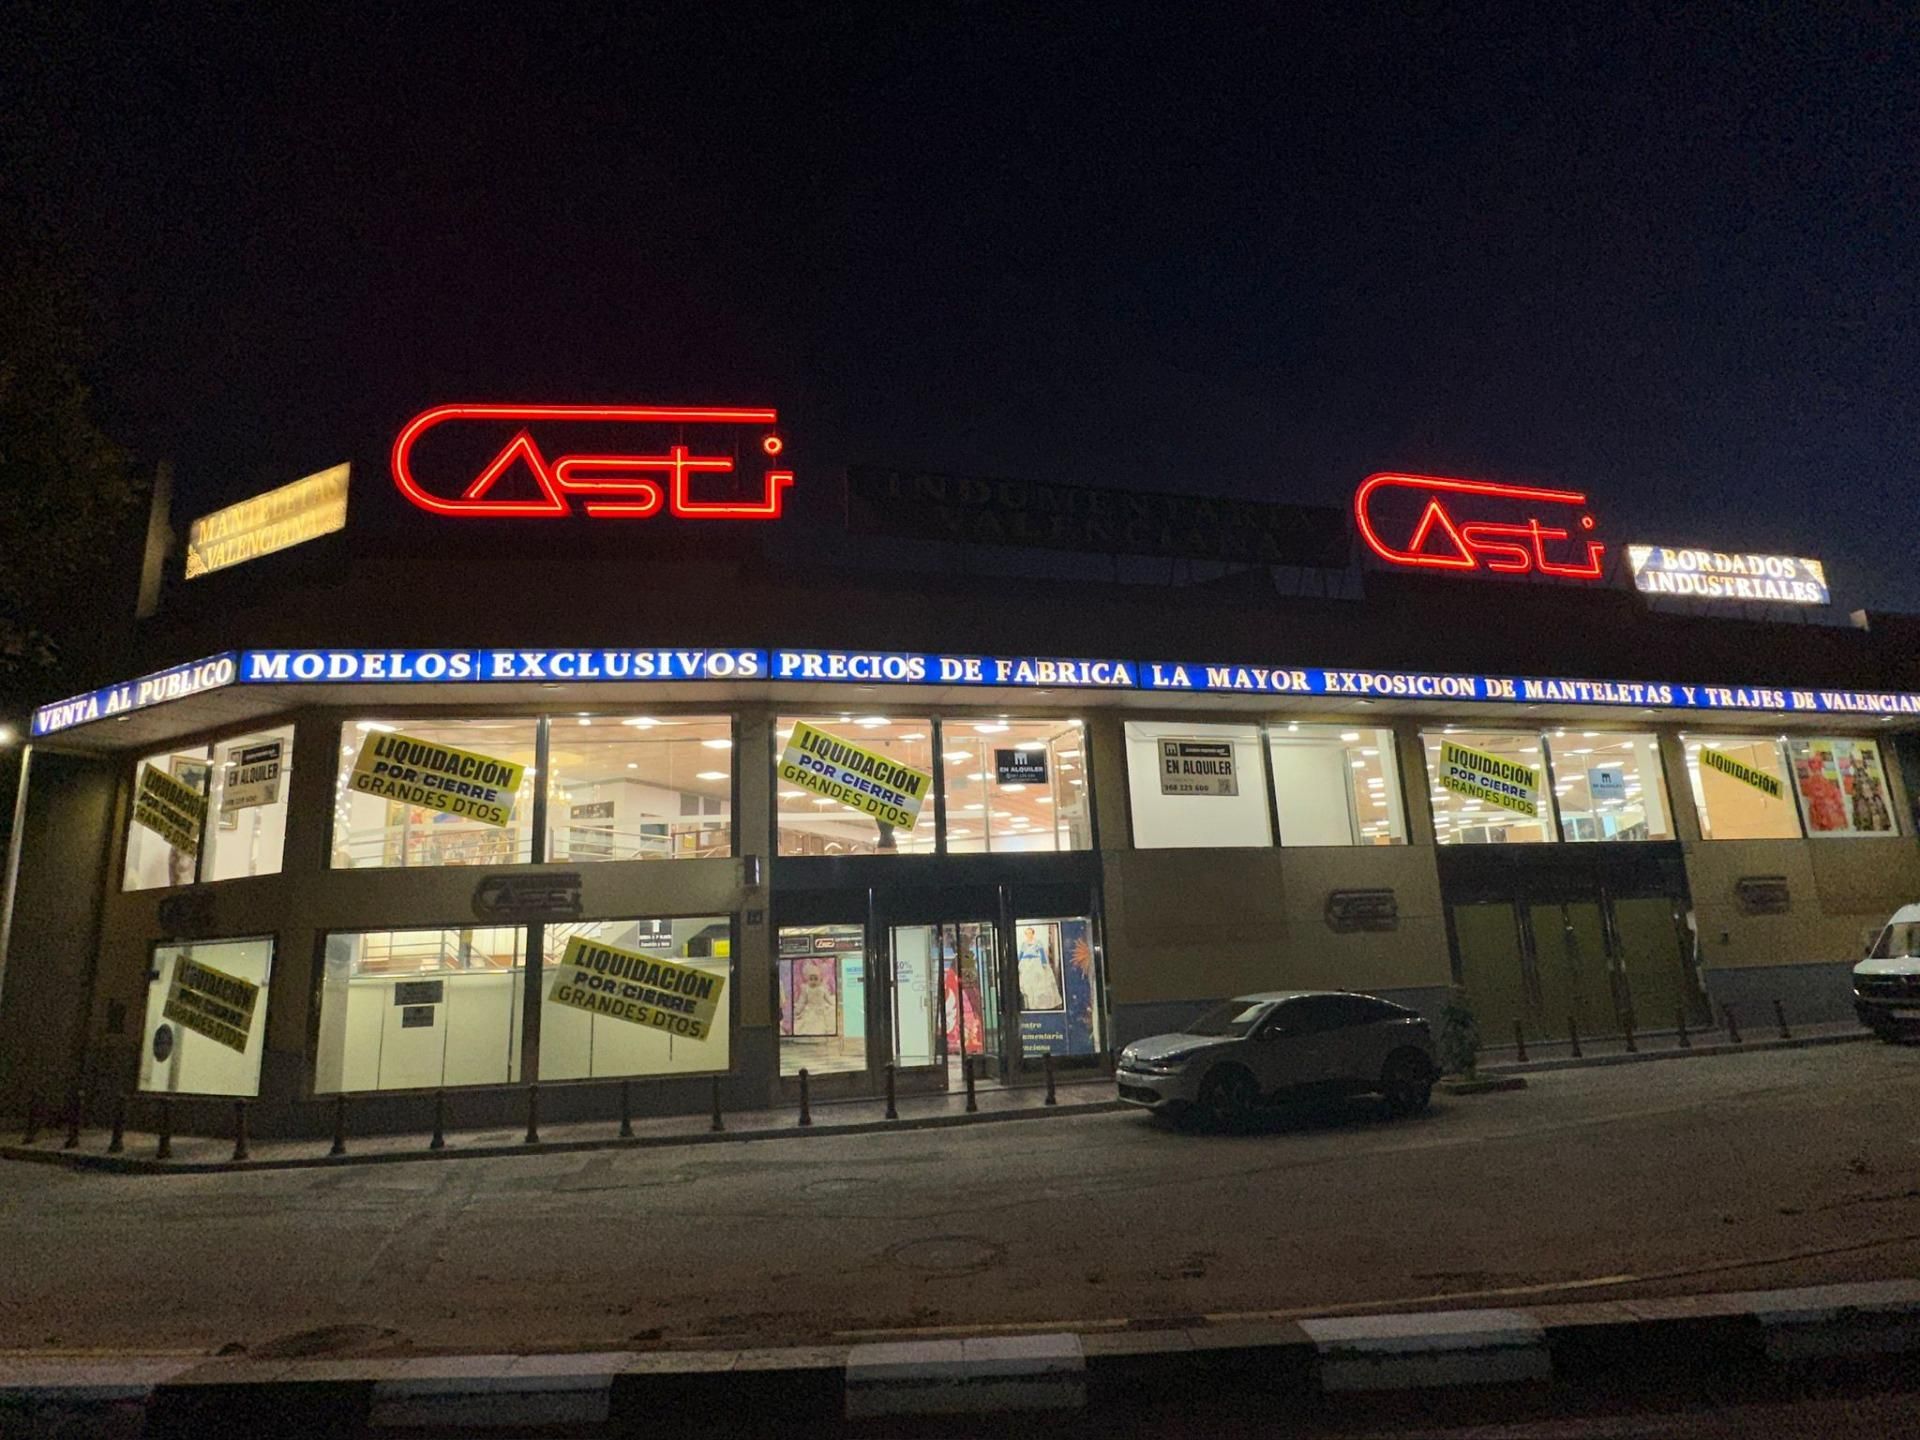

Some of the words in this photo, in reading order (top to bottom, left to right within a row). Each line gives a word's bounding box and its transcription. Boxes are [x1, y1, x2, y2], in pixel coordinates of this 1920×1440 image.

[205, 507, 319, 570] VALENCIANA
[1646, 569, 1822, 602] INDUSTRIALES
[1662, 548, 1797, 579] BORDADOS
[37, 696, 99, 734] VENTA
[106, 685, 132, 714] AL
[139, 657, 233, 705] PUBLICO
[250, 653, 472, 679] MODELOS
[492, 652, 759, 679] EXCLUSIVOS
[779, 653, 926, 680] PRECIOS
[940, 657, 983, 682] DE
[996, 659, 1132, 686] FABRICA
[1152, 664, 1192, 687] LA
[1206, 667, 1310, 692] MAYOR
[1324, 671, 1475, 698] EXPOSICION
[1485, 678, 1516, 699] DE
[1524, 679, 1672, 705] MANTELETAS
[1681, 686, 1697, 706] Y
[1705, 687, 1785, 709] TRAJES
[1790, 691, 1817, 710] DE
[228, 769, 240, 788] EN
[240, 763, 279, 786] ALQUILER
[373, 761, 420, 785] POR
[423, 771, 498, 802] CIERRE
[374, 737, 513, 788] LIQUIDACIÓN
[798, 754, 837, 780] POR
[840, 770, 906, 807] CIERRE
[800, 730, 921, 796] LIQUIDACIÓN
[1165, 759, 1180, 775] EN
[1183, 760, 1232, 776] ALQUILER
[1447, 745, 1534, 787] LIQUIDACIÓN
[1449, 766, 1478, 783] POR
[1480, 773, 1528, 798] CIERRE
[1705, 750, 1779, 796] LIQUIDACIÓN
[357, 773, 449, 810] GRANDES
[453, 798, 505, 824] DTOS.
[783, 764, 864, 808] GRANDES
[866, 798, 913, 829] DTOS.
[1442, 778, 1501, 806] GRANDES
[573, 971, 616, 994] POR
[621, 982, 697, 1014] CIERRE
[574, 943, 714, 999] LIQUIDACIÓN
[557, 984, 649, 1022] GRANDES
[652, 1011, 707, 1039] DTOS.
